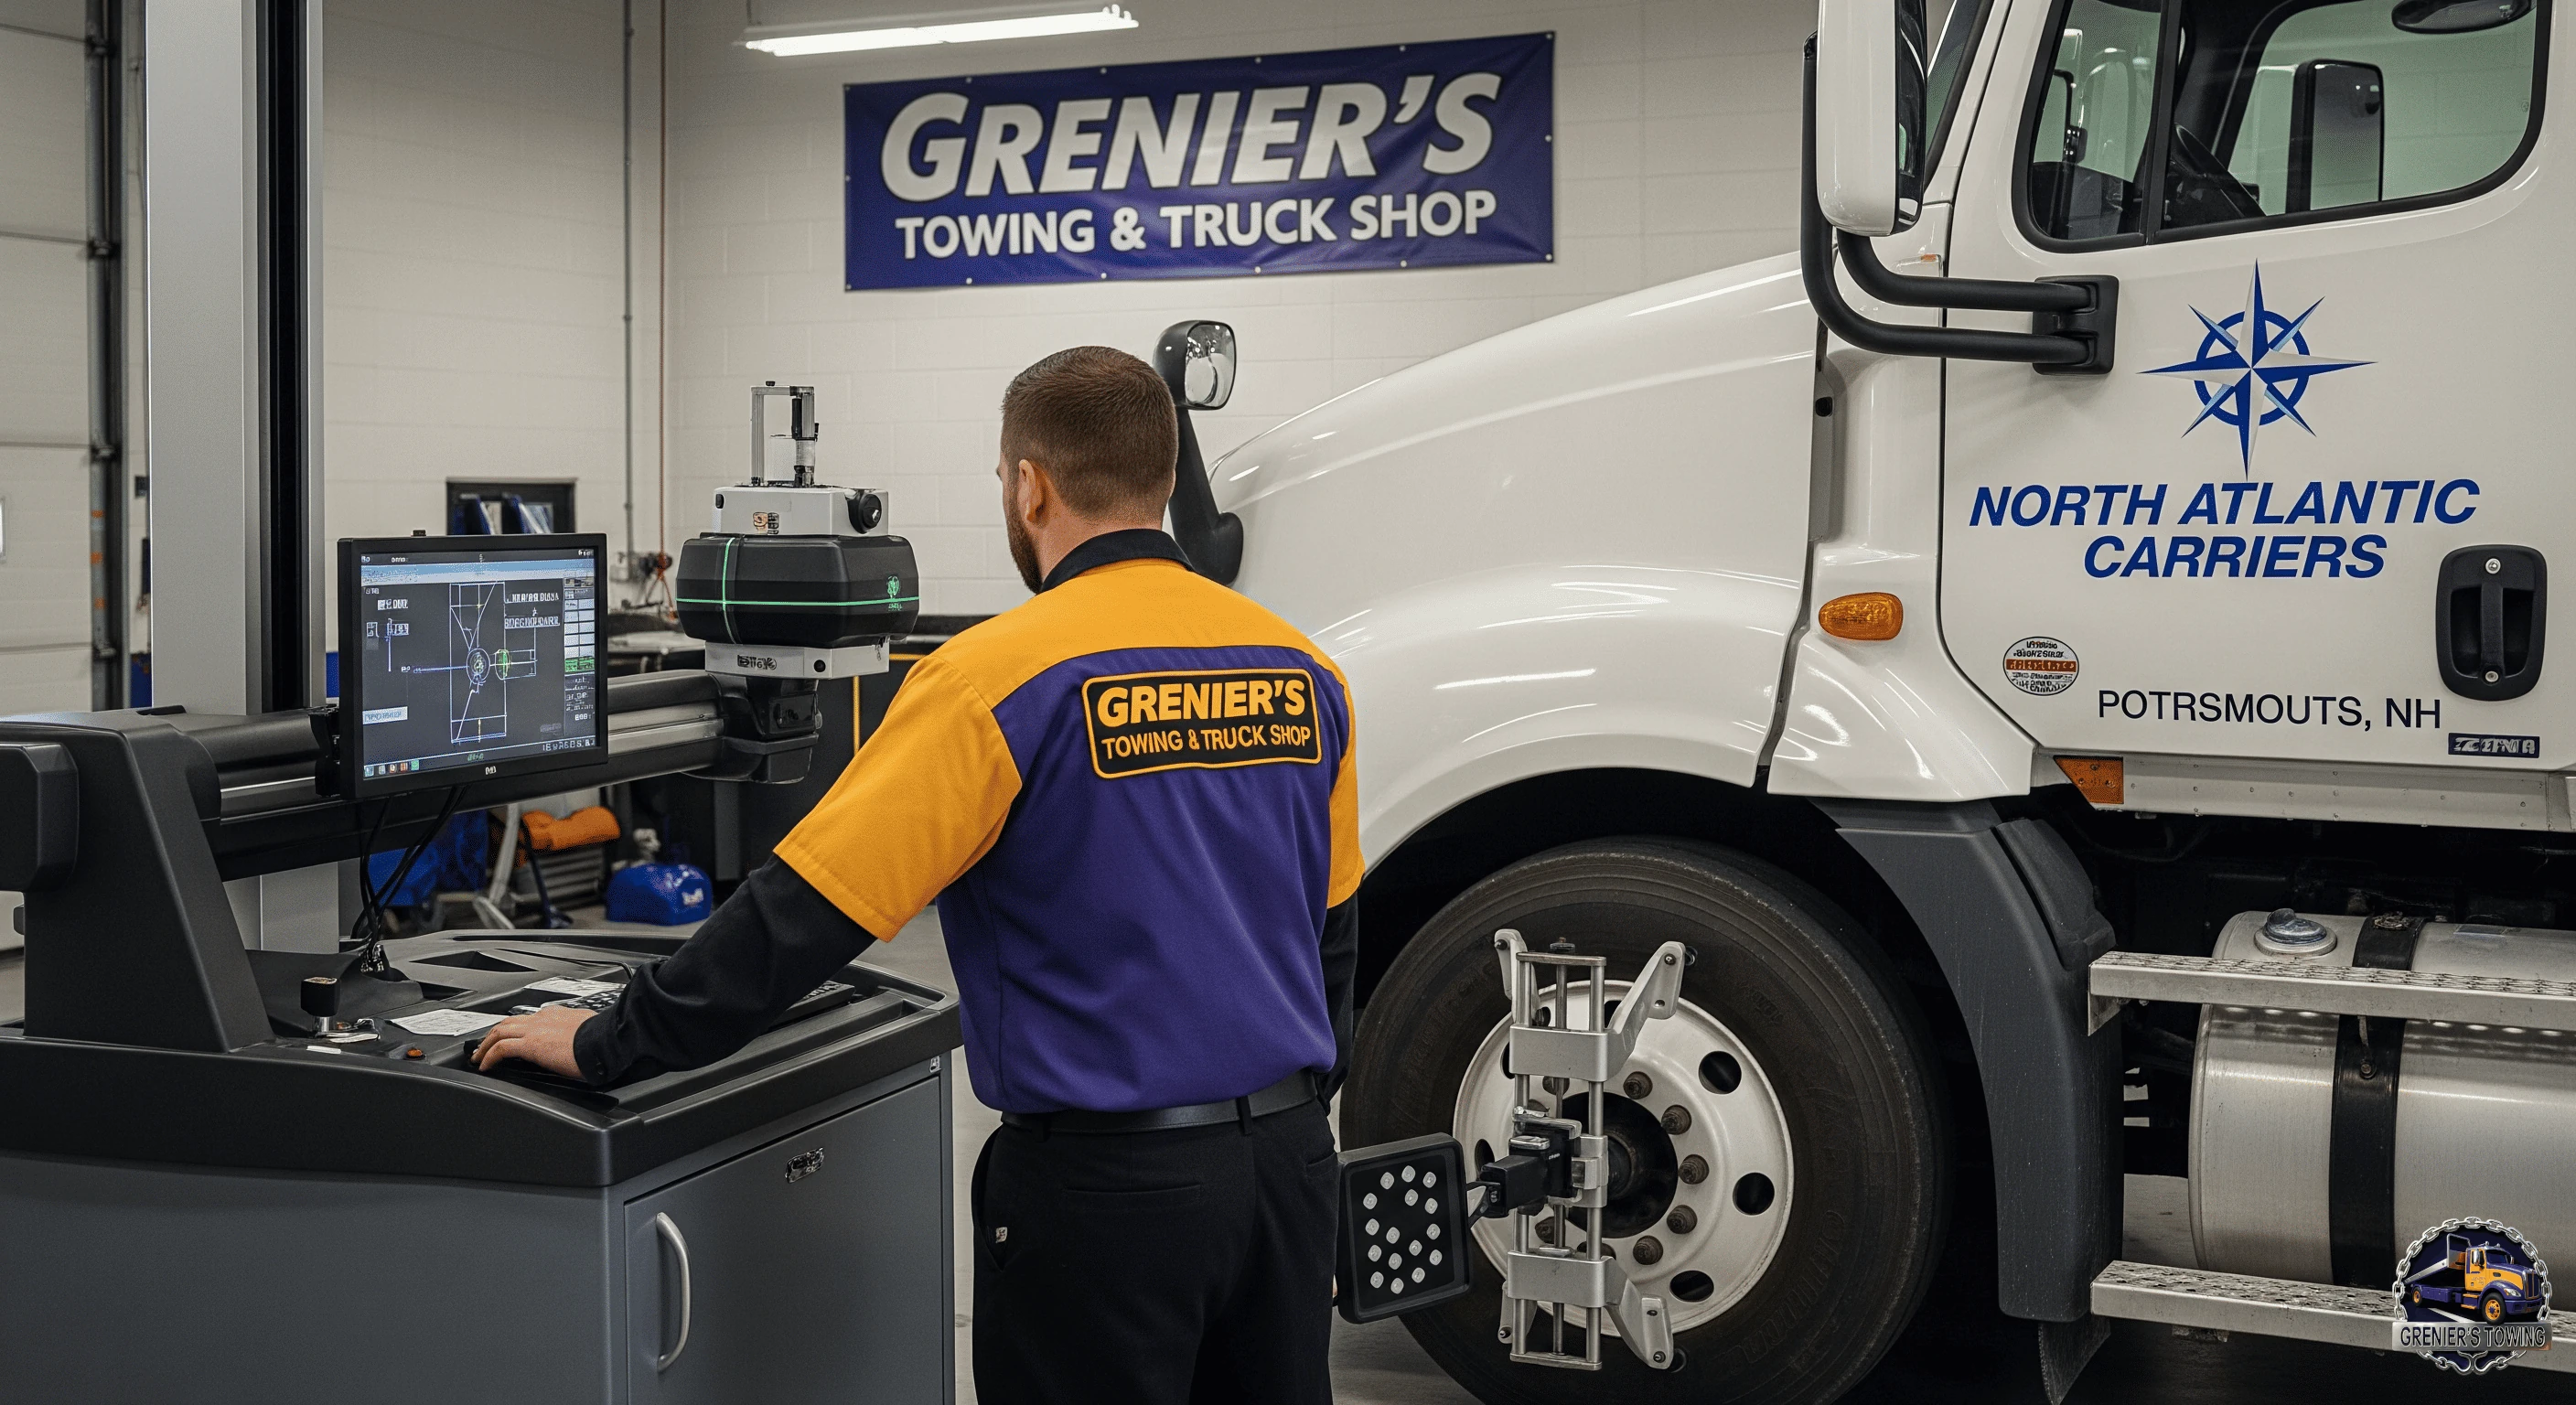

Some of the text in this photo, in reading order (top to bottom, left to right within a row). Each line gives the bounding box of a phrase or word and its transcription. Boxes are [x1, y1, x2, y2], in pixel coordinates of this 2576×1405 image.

[882, 74, 1500, 201] GRENIER'S
[895, 190, 1497, 259] TOWING & TRUCK SHOP
[1970, 478, 2480, 527] NORTH ATLANTIC
[2084, 535, 2387, 578] CARRIERS
[1097, 679, 1305, 728] GRENIER'S
[2098, 690, 2441, 732] POTRSMOUTS, NH
[1100, 724, 1311, 760] TOWING & TRUCK SHOP
